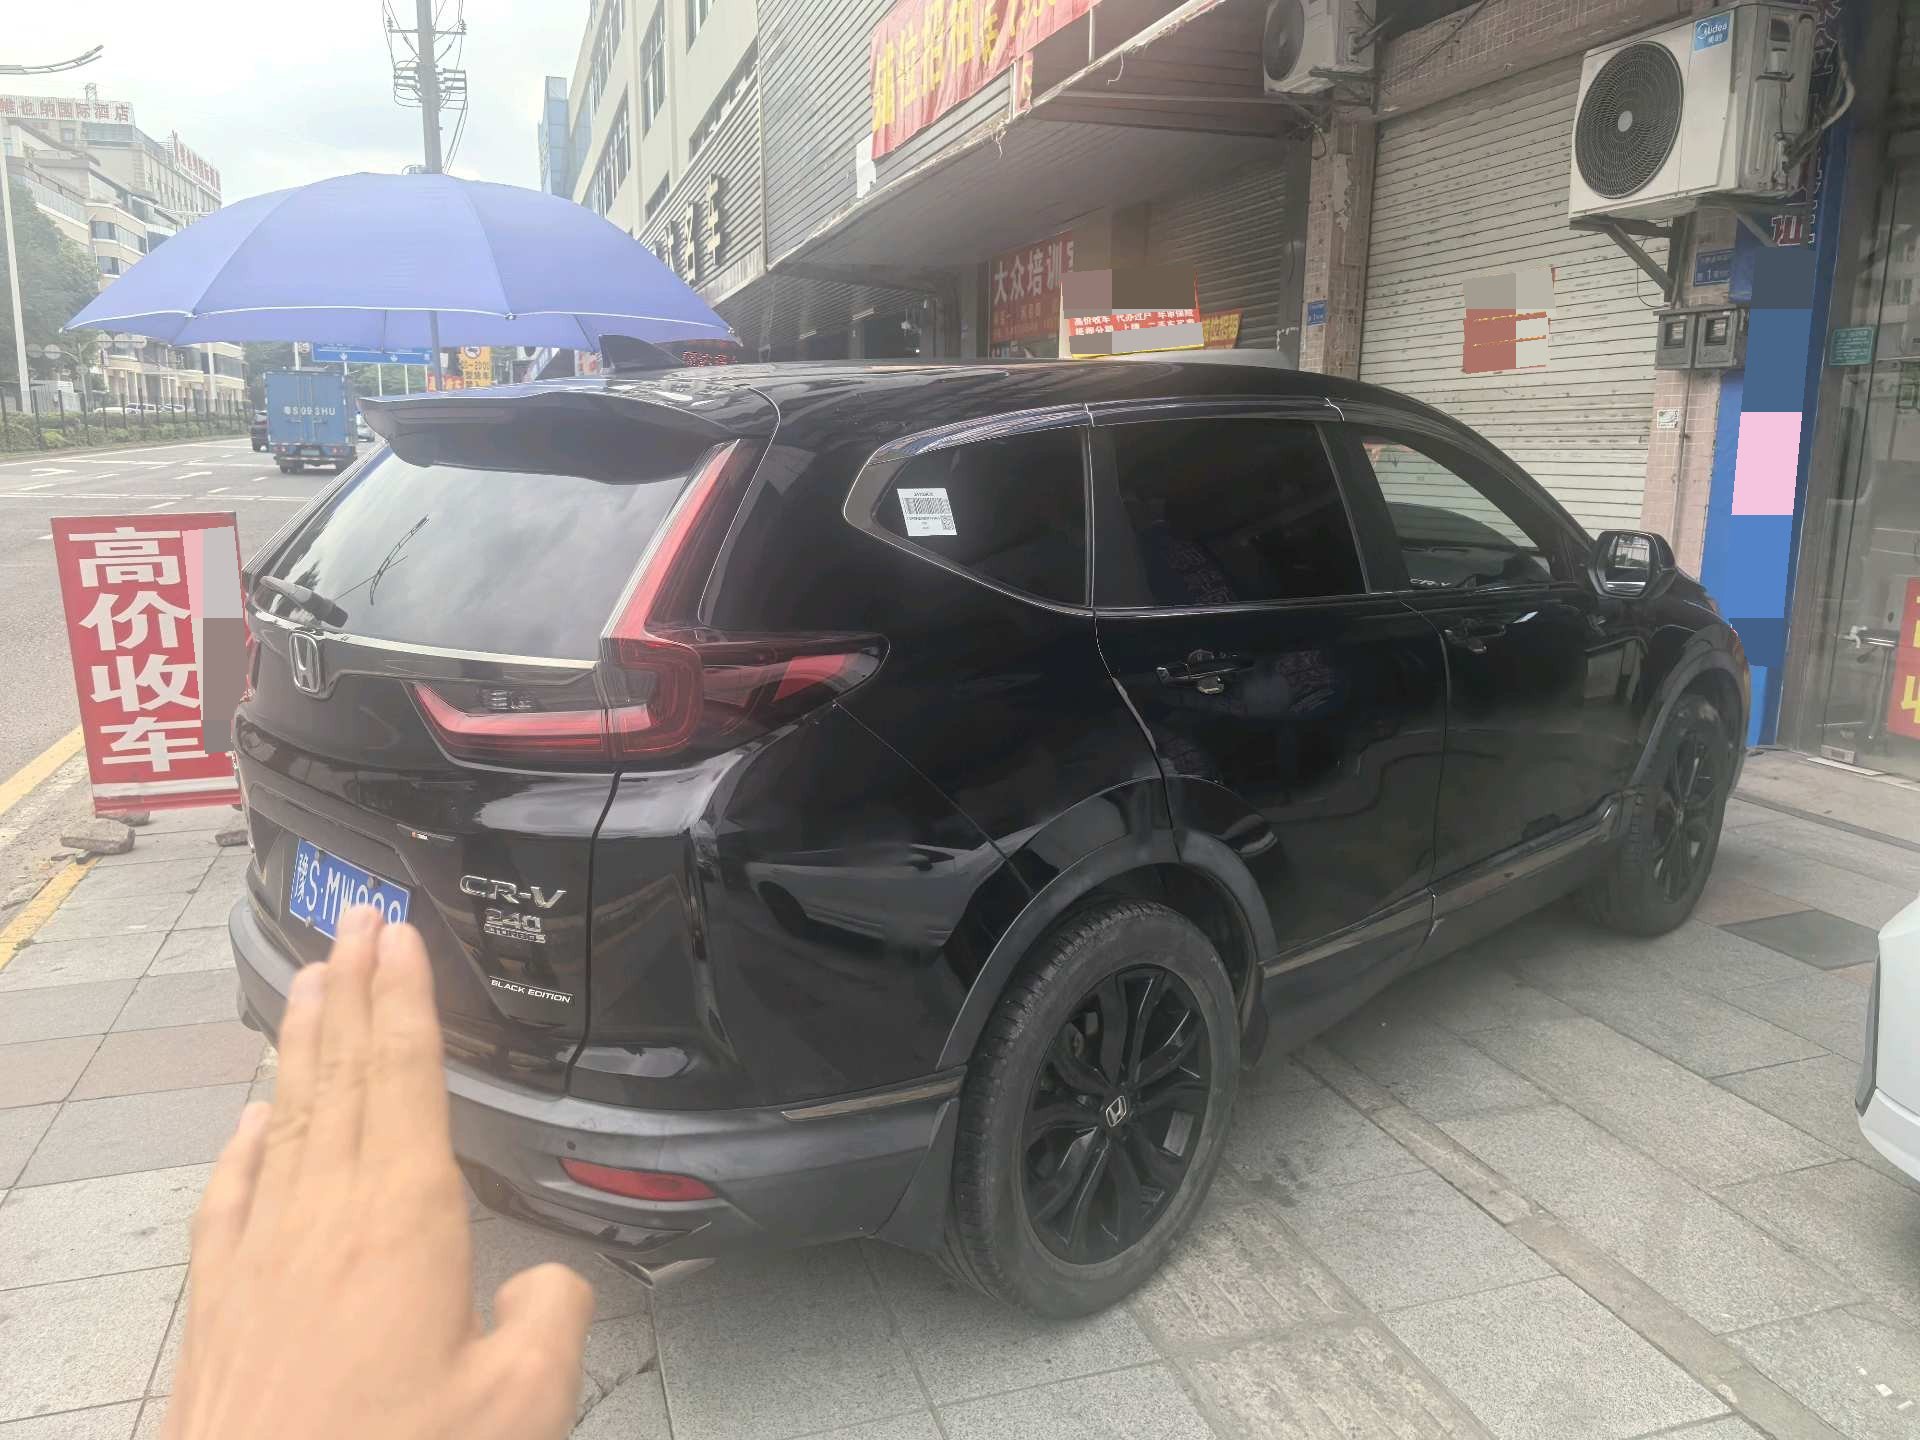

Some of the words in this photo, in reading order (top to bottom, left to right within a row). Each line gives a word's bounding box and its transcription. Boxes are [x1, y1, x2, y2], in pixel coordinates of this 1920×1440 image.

[69, 527, 208, 772] 高价收车
[460, 875, 567, 908] CR-V
[485, 907, 542, 932] 240
[491, 980, 525, 994] BLACK
[528, 989, 571, 1003] EDITION
